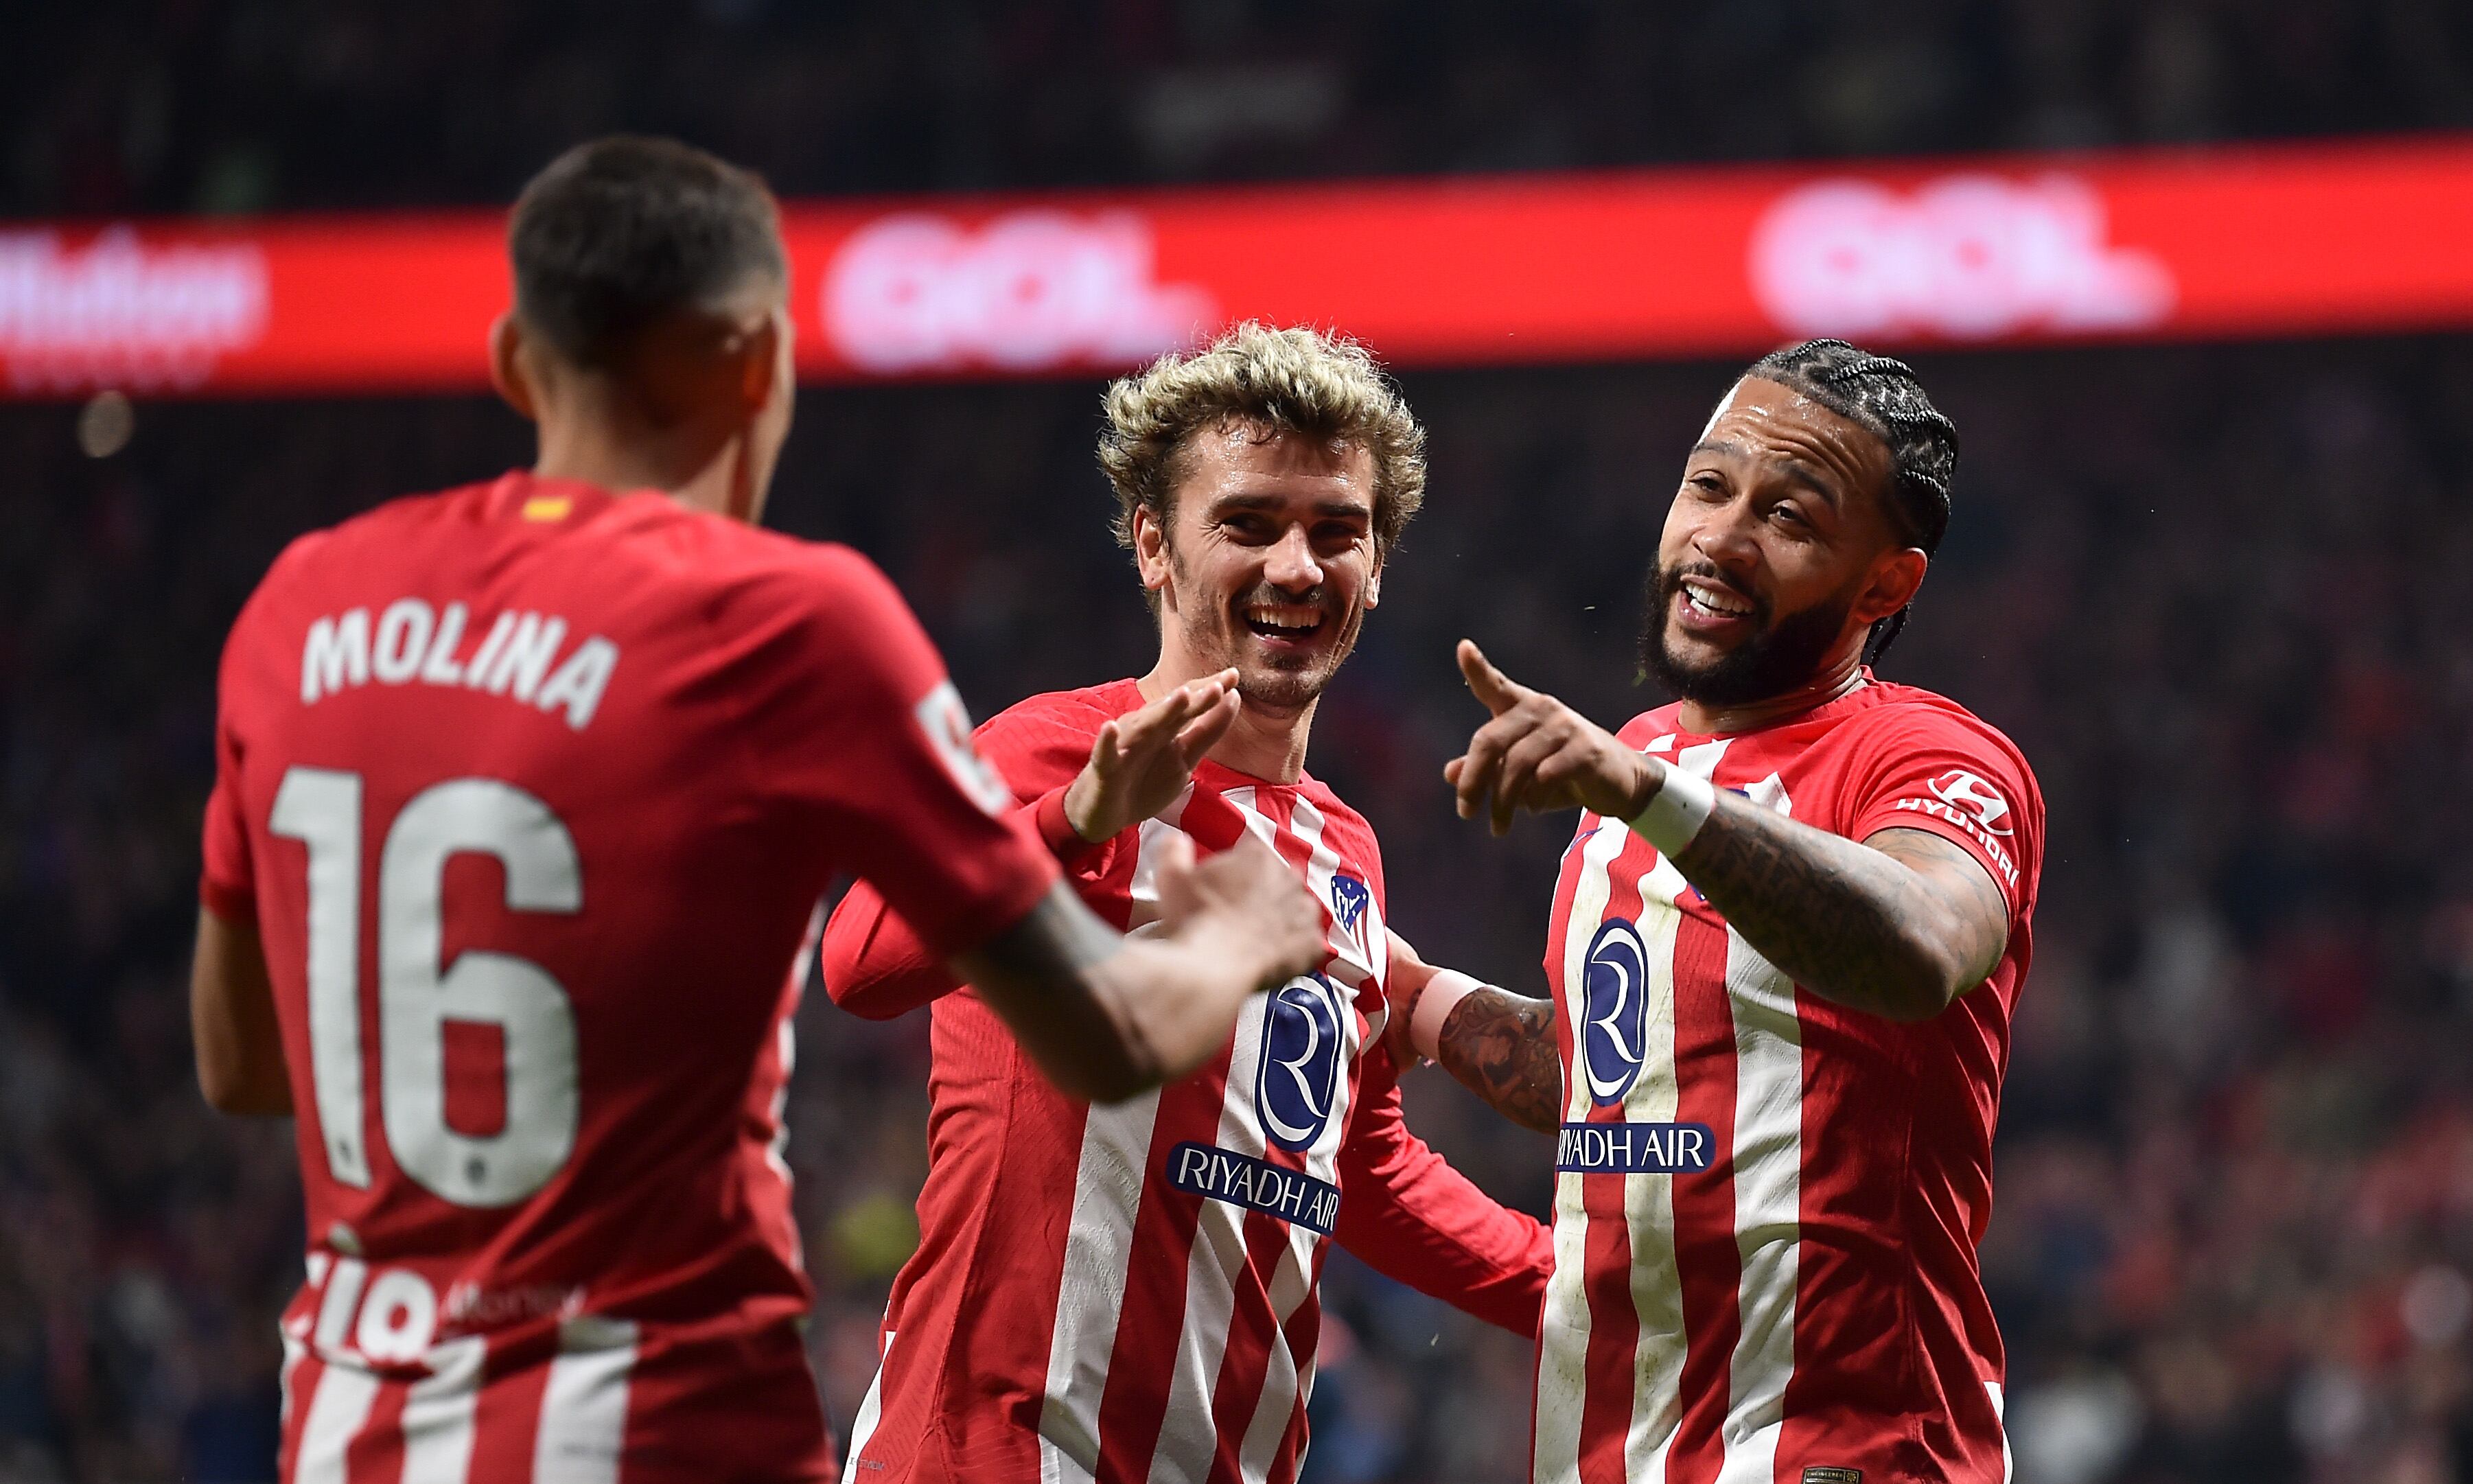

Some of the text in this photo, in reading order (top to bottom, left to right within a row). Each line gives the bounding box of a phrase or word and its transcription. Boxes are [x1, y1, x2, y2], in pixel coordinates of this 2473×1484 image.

[300, 596, 620, 731] MOLINA
[270, 765, 583, 1208] 16
[1178, 1148, 1338, 1232] RIYADH AIR
[1556, 1129, 1704, 1167] RIYADH AIR
